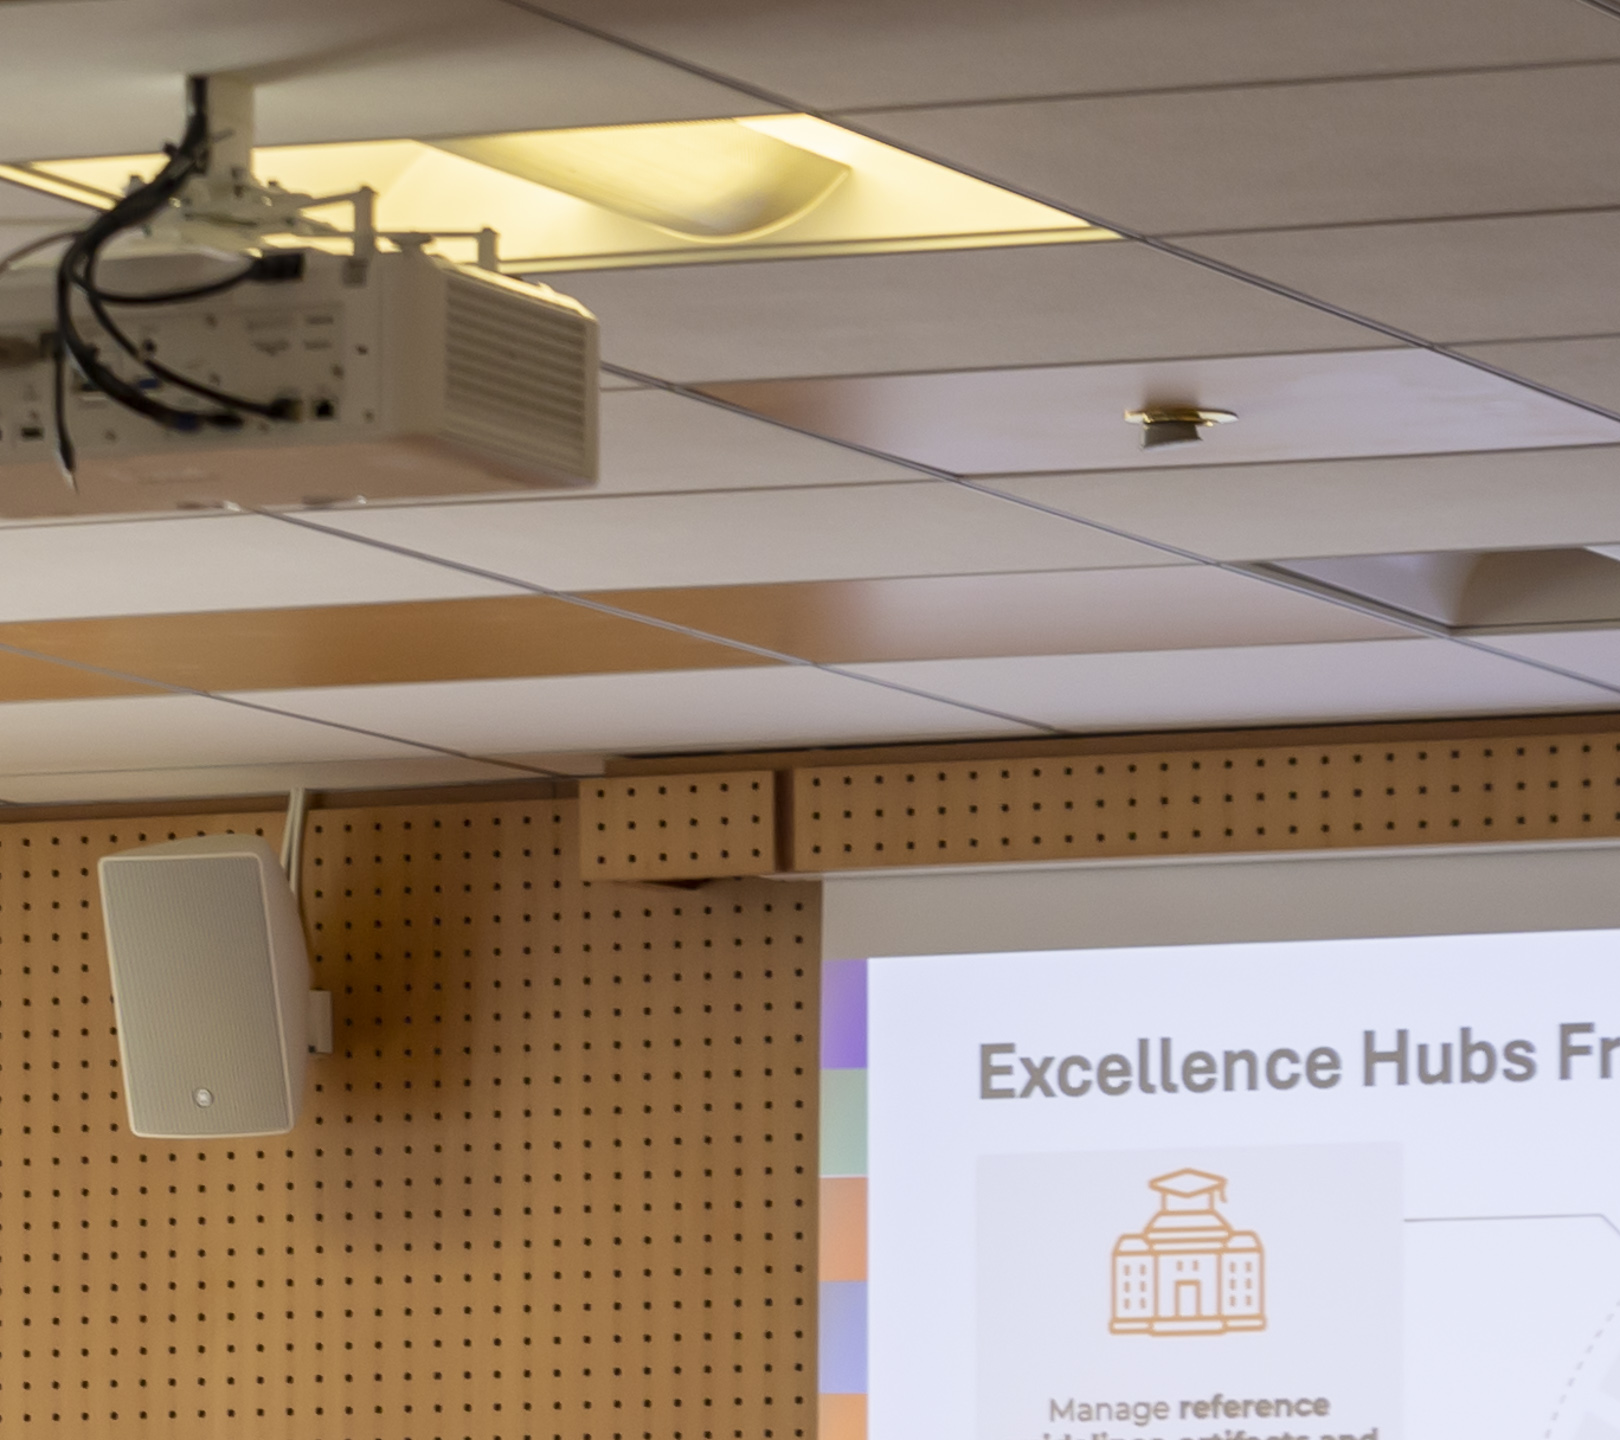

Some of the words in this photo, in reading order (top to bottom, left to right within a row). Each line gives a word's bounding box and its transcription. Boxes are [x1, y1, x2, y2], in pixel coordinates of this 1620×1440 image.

[977, 1037, 1342, 1101] Excellence
[1362, 1025, 1537, 1088] Hubs
[1049, 1398, 1170, 1426] Manage
[1180, 1394, 1330, 1419] reference
